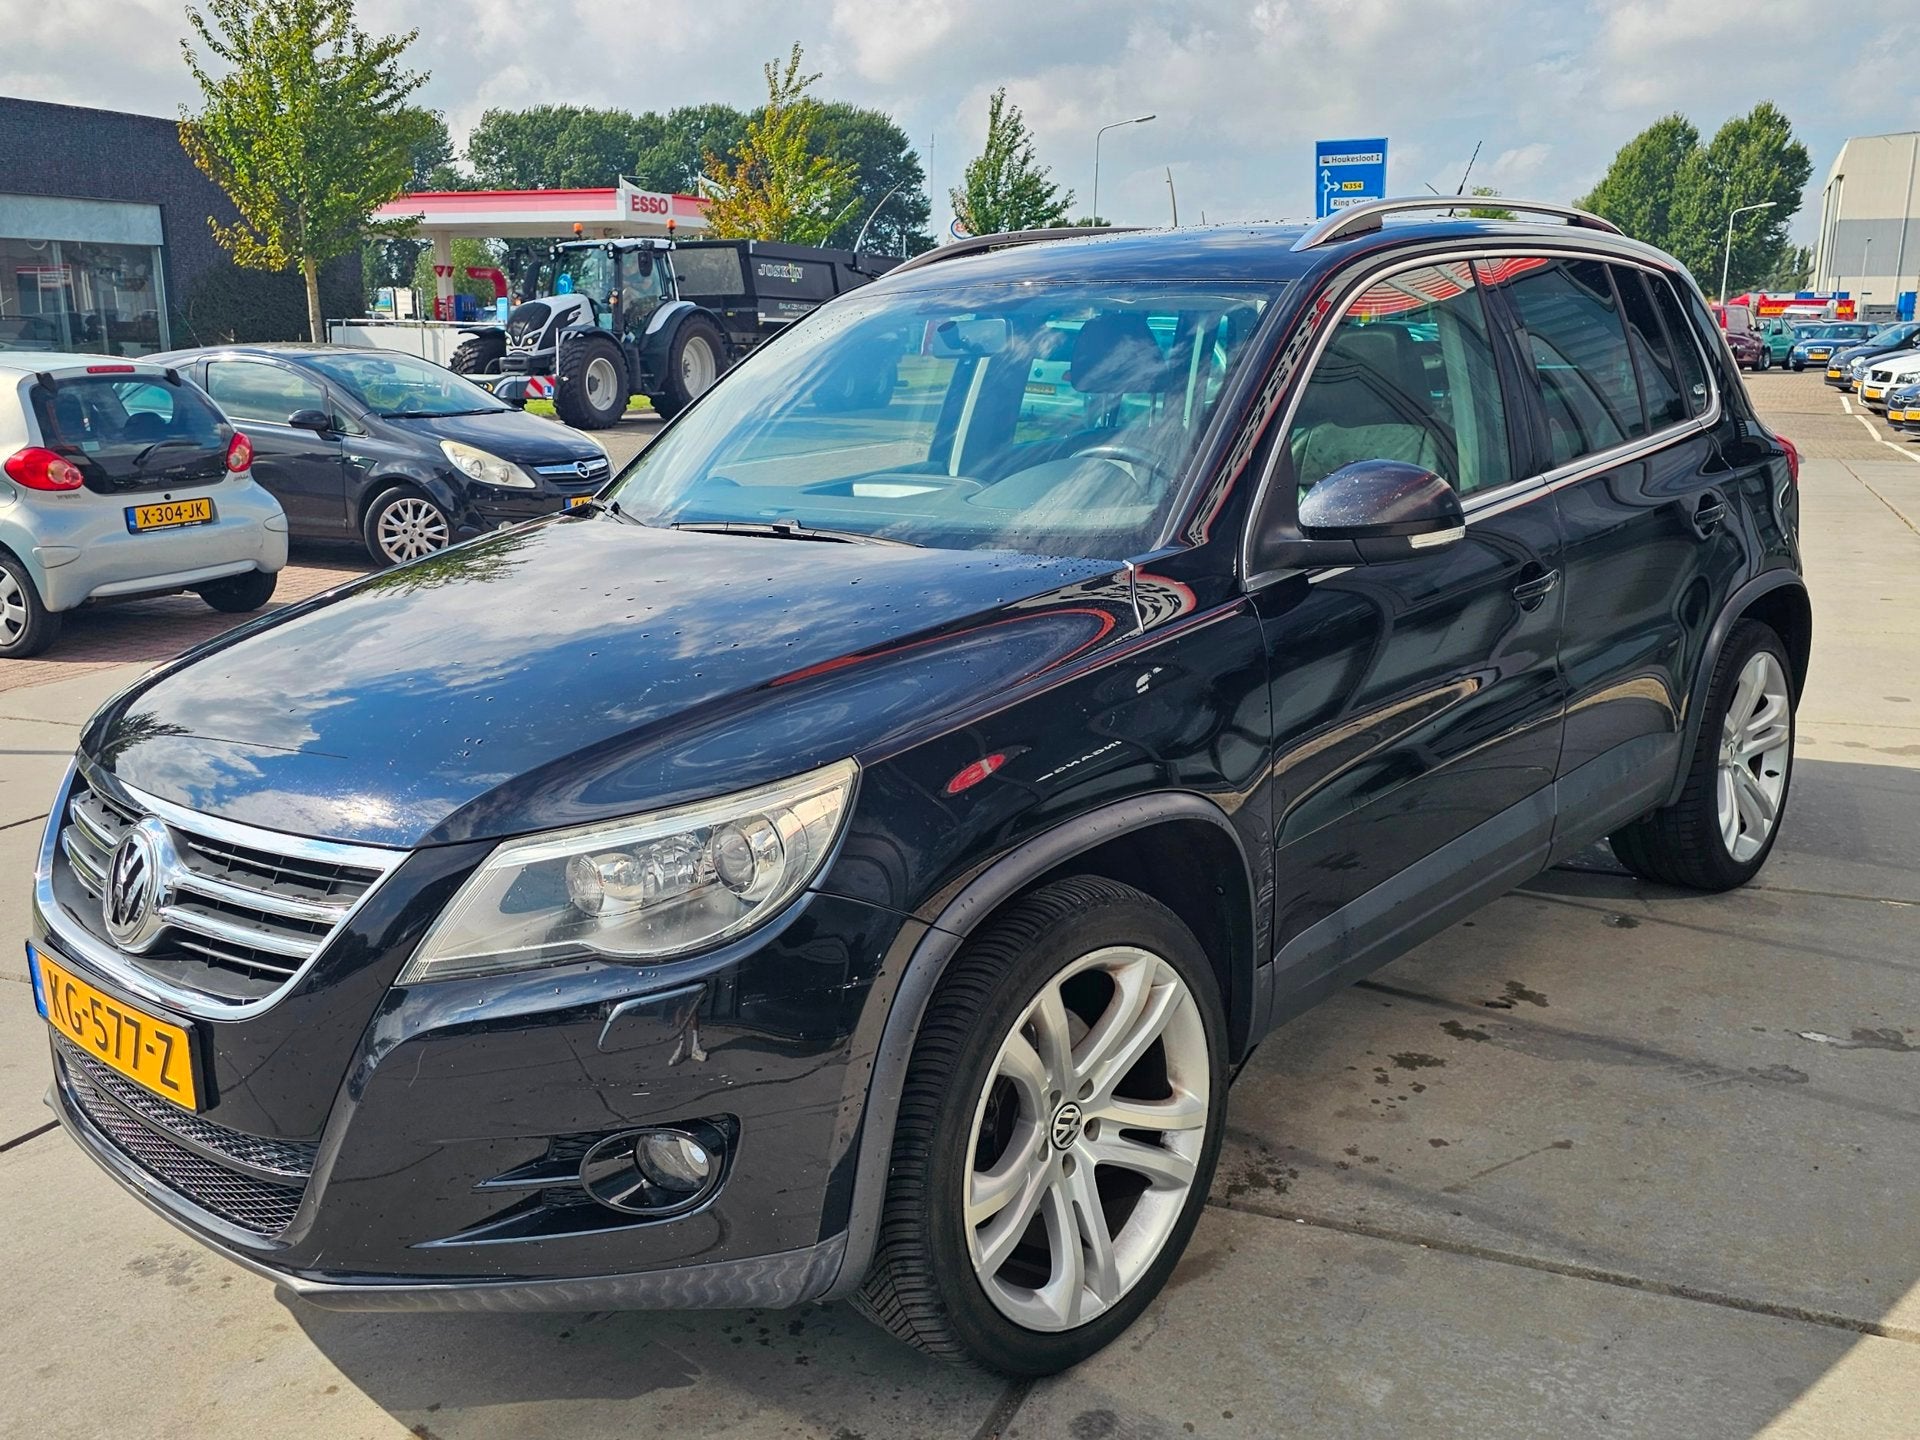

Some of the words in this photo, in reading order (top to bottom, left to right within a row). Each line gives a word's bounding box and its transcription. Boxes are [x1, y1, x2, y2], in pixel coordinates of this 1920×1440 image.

[1332, 155, 1374, 163] Houkesloot
[631, 194, 669, 215] ESSO
[1333, 199, 1350, 207] Ring
[757, 263, 804, 281] JOSKIN
[141, 502, 205, 525] X-304-JK
[47, 969, 180, 1092] KG-577-Z
